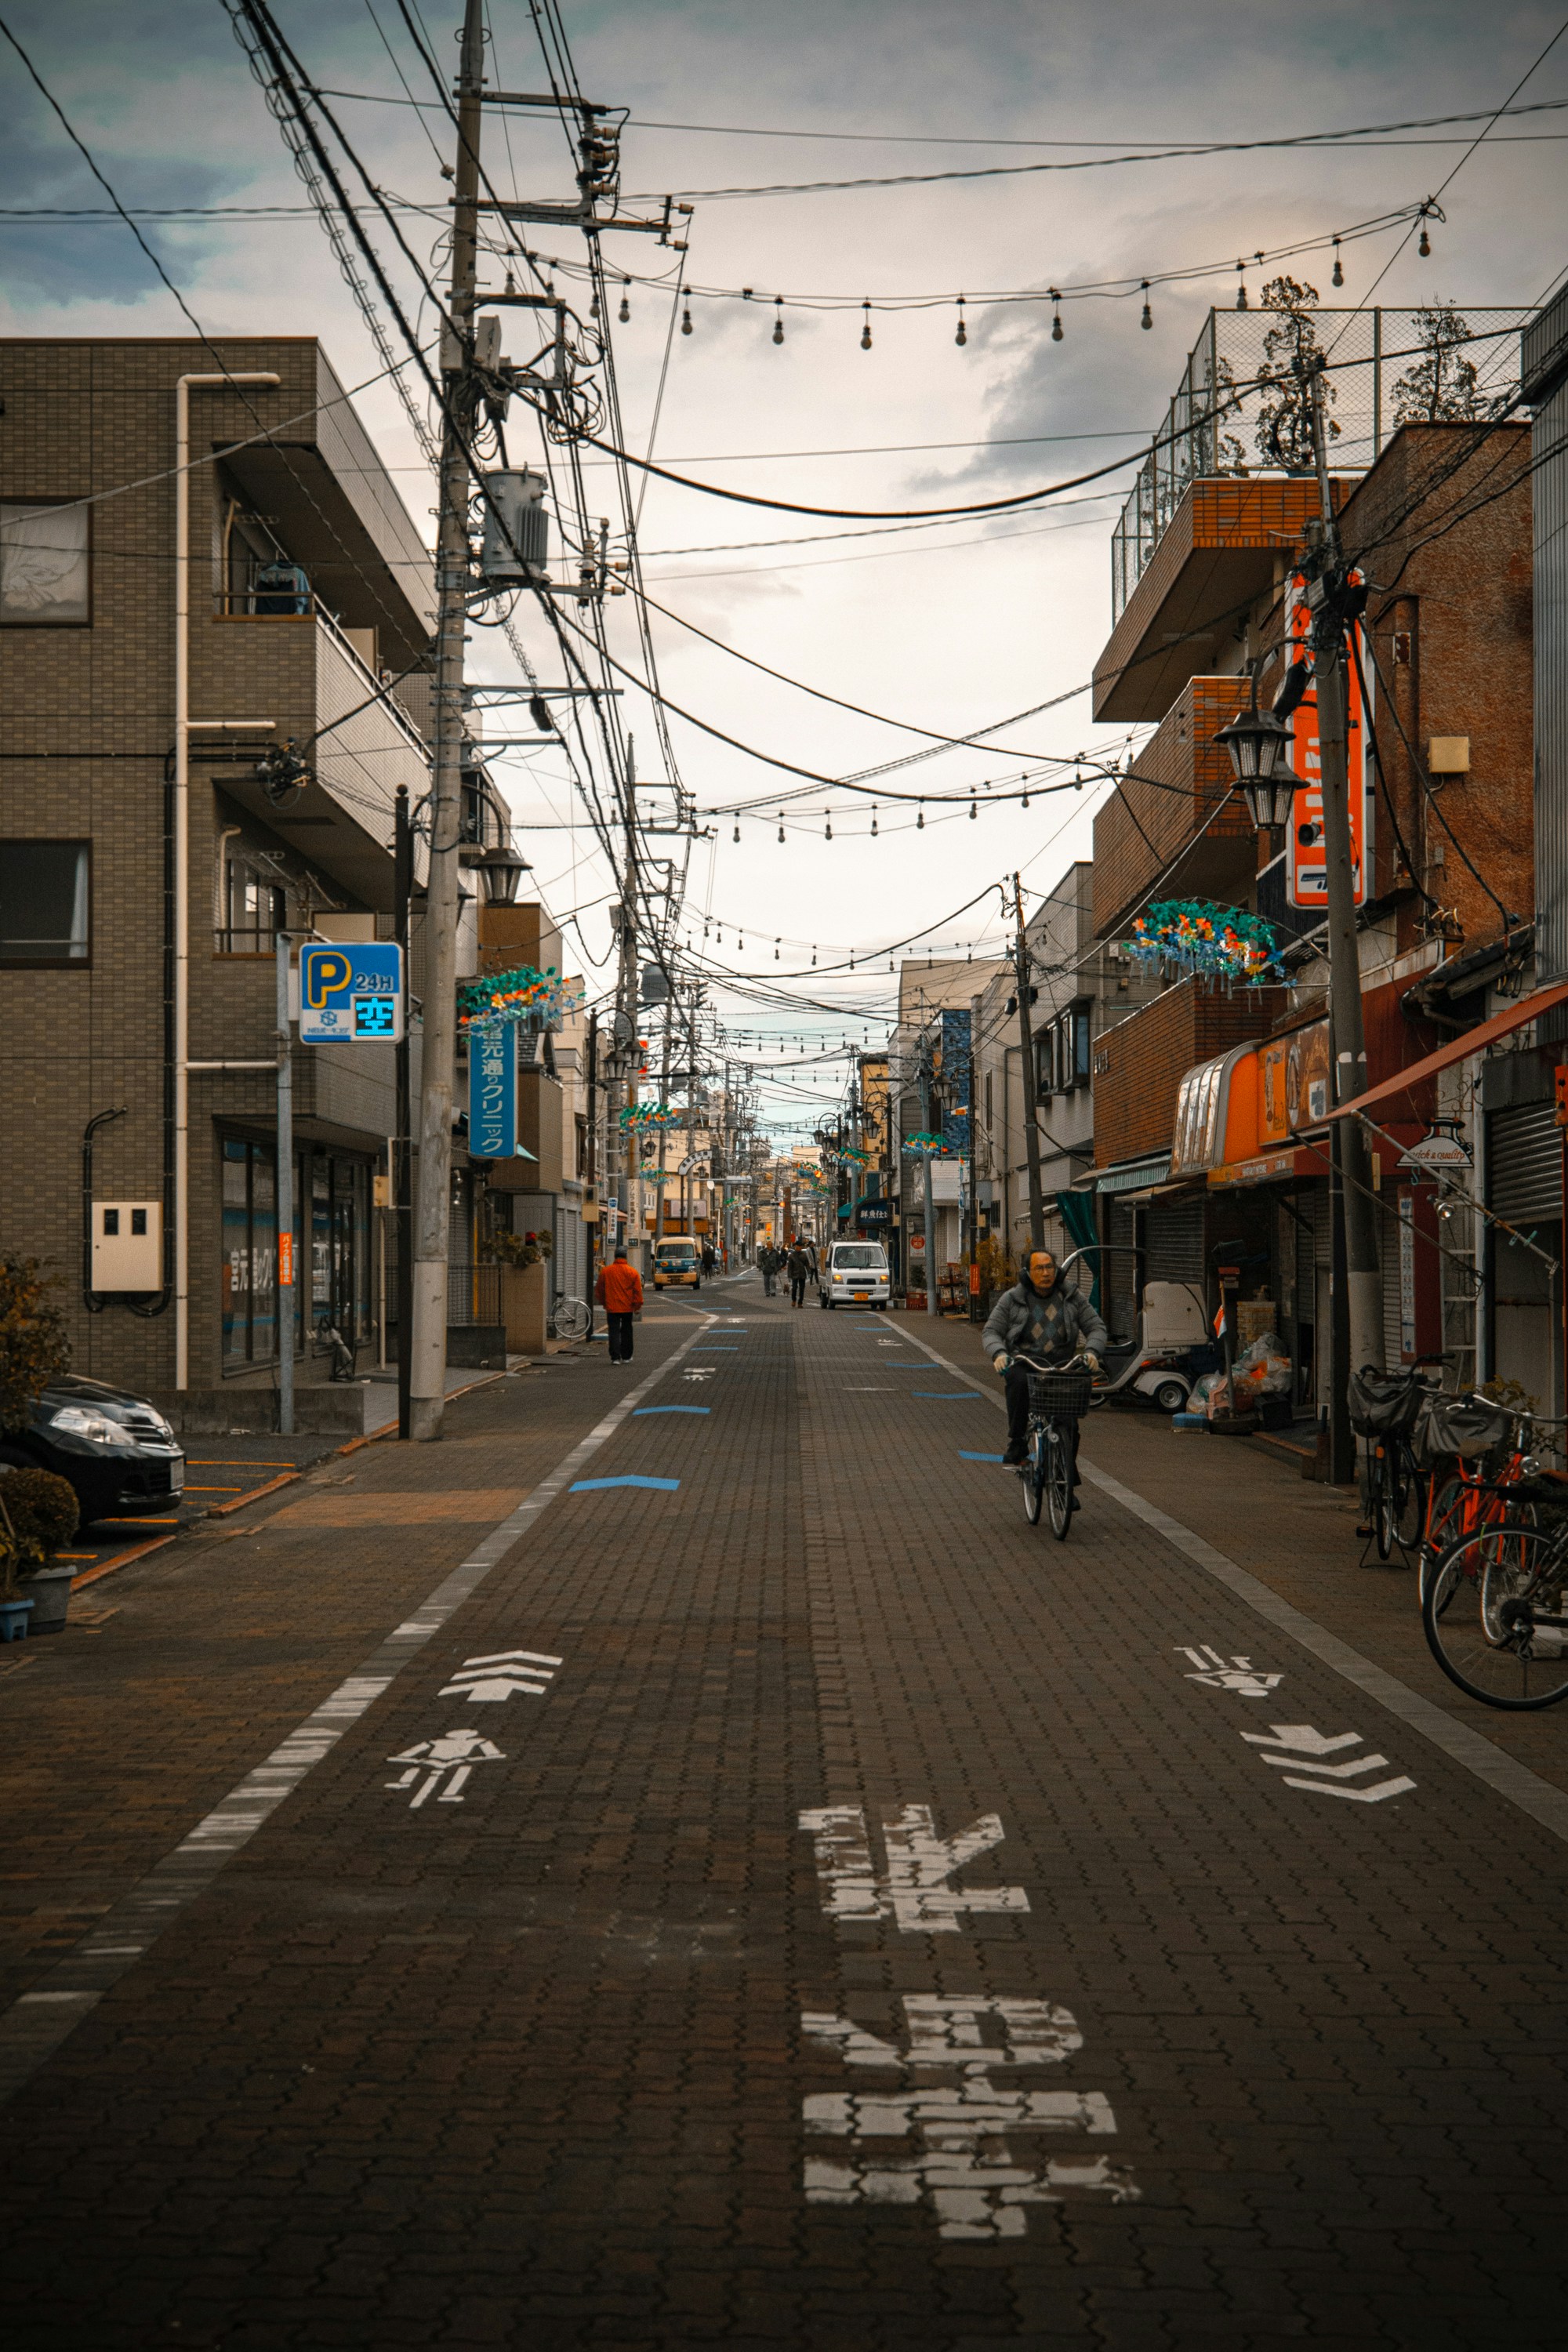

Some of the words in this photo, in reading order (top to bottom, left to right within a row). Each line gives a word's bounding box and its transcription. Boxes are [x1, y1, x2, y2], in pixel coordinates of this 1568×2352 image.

[308, 952, 352, 1009] P
[355, 973, 394, 991] 24H
[355, 997, 394, 1036] 空
[1410, 1149, 1430, 1160] uick
